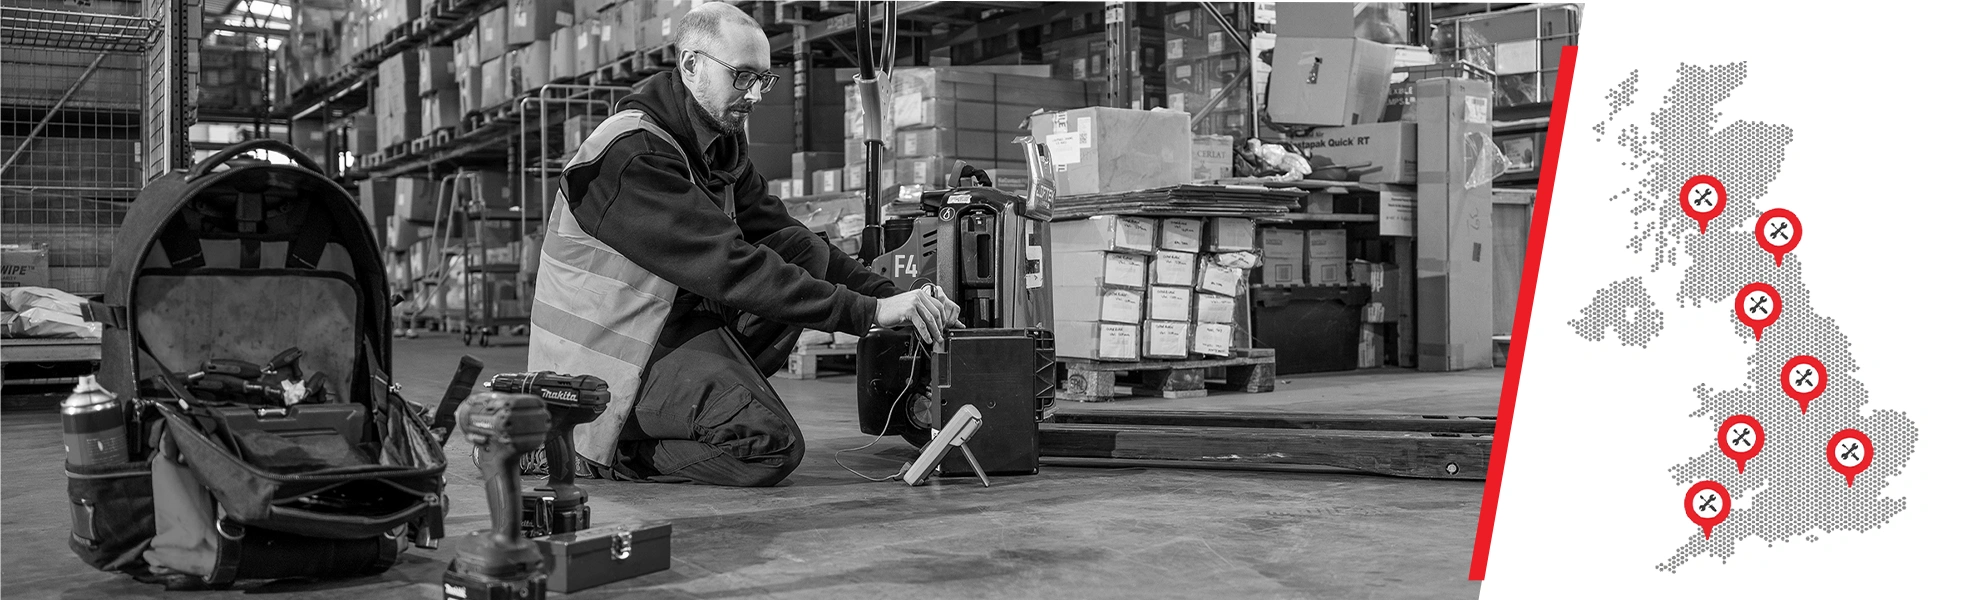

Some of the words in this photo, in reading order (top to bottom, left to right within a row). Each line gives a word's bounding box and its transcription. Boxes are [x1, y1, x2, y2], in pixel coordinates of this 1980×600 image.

[1328, 137, 1354, 148] Quick
[1357, 136, 1370, 145] RT
[895, 254, 918, 277] F4
